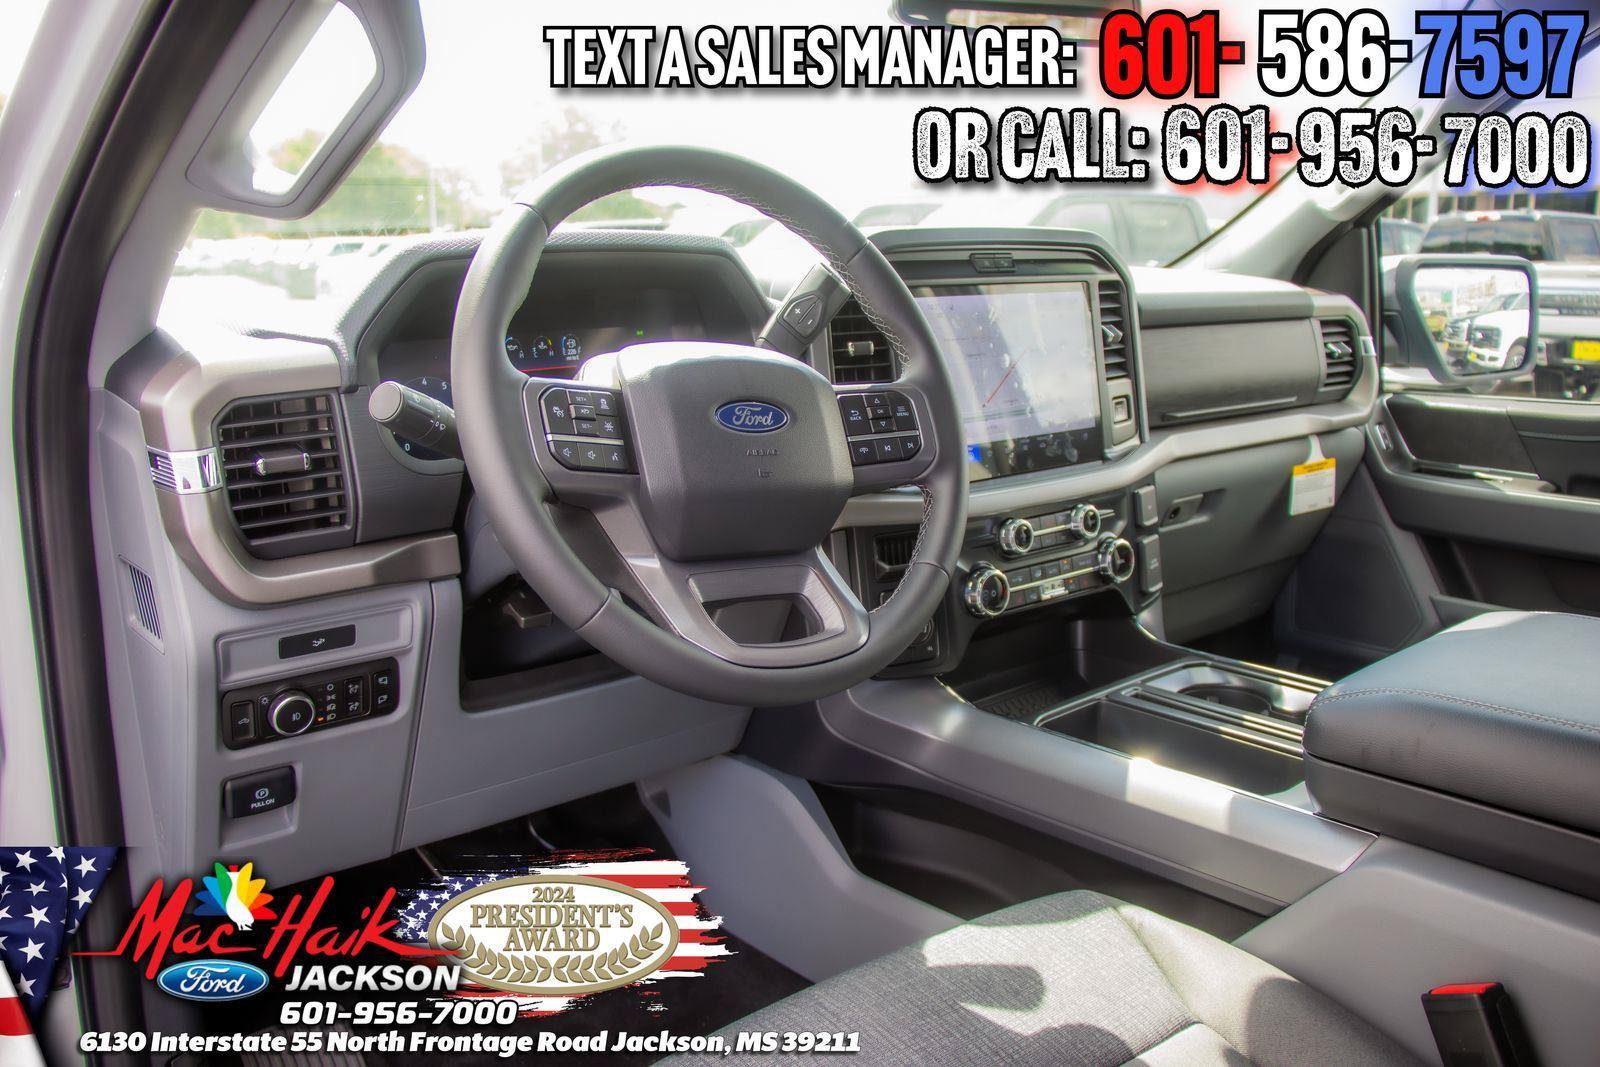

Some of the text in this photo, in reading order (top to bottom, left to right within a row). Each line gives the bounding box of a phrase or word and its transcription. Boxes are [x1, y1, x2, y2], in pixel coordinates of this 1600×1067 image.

[421, 377, 428, 386] 4
[441, 381, 448, 390] 5
[732, 405, 775, 427] Ford
[404, 443, 411, 452] 0
